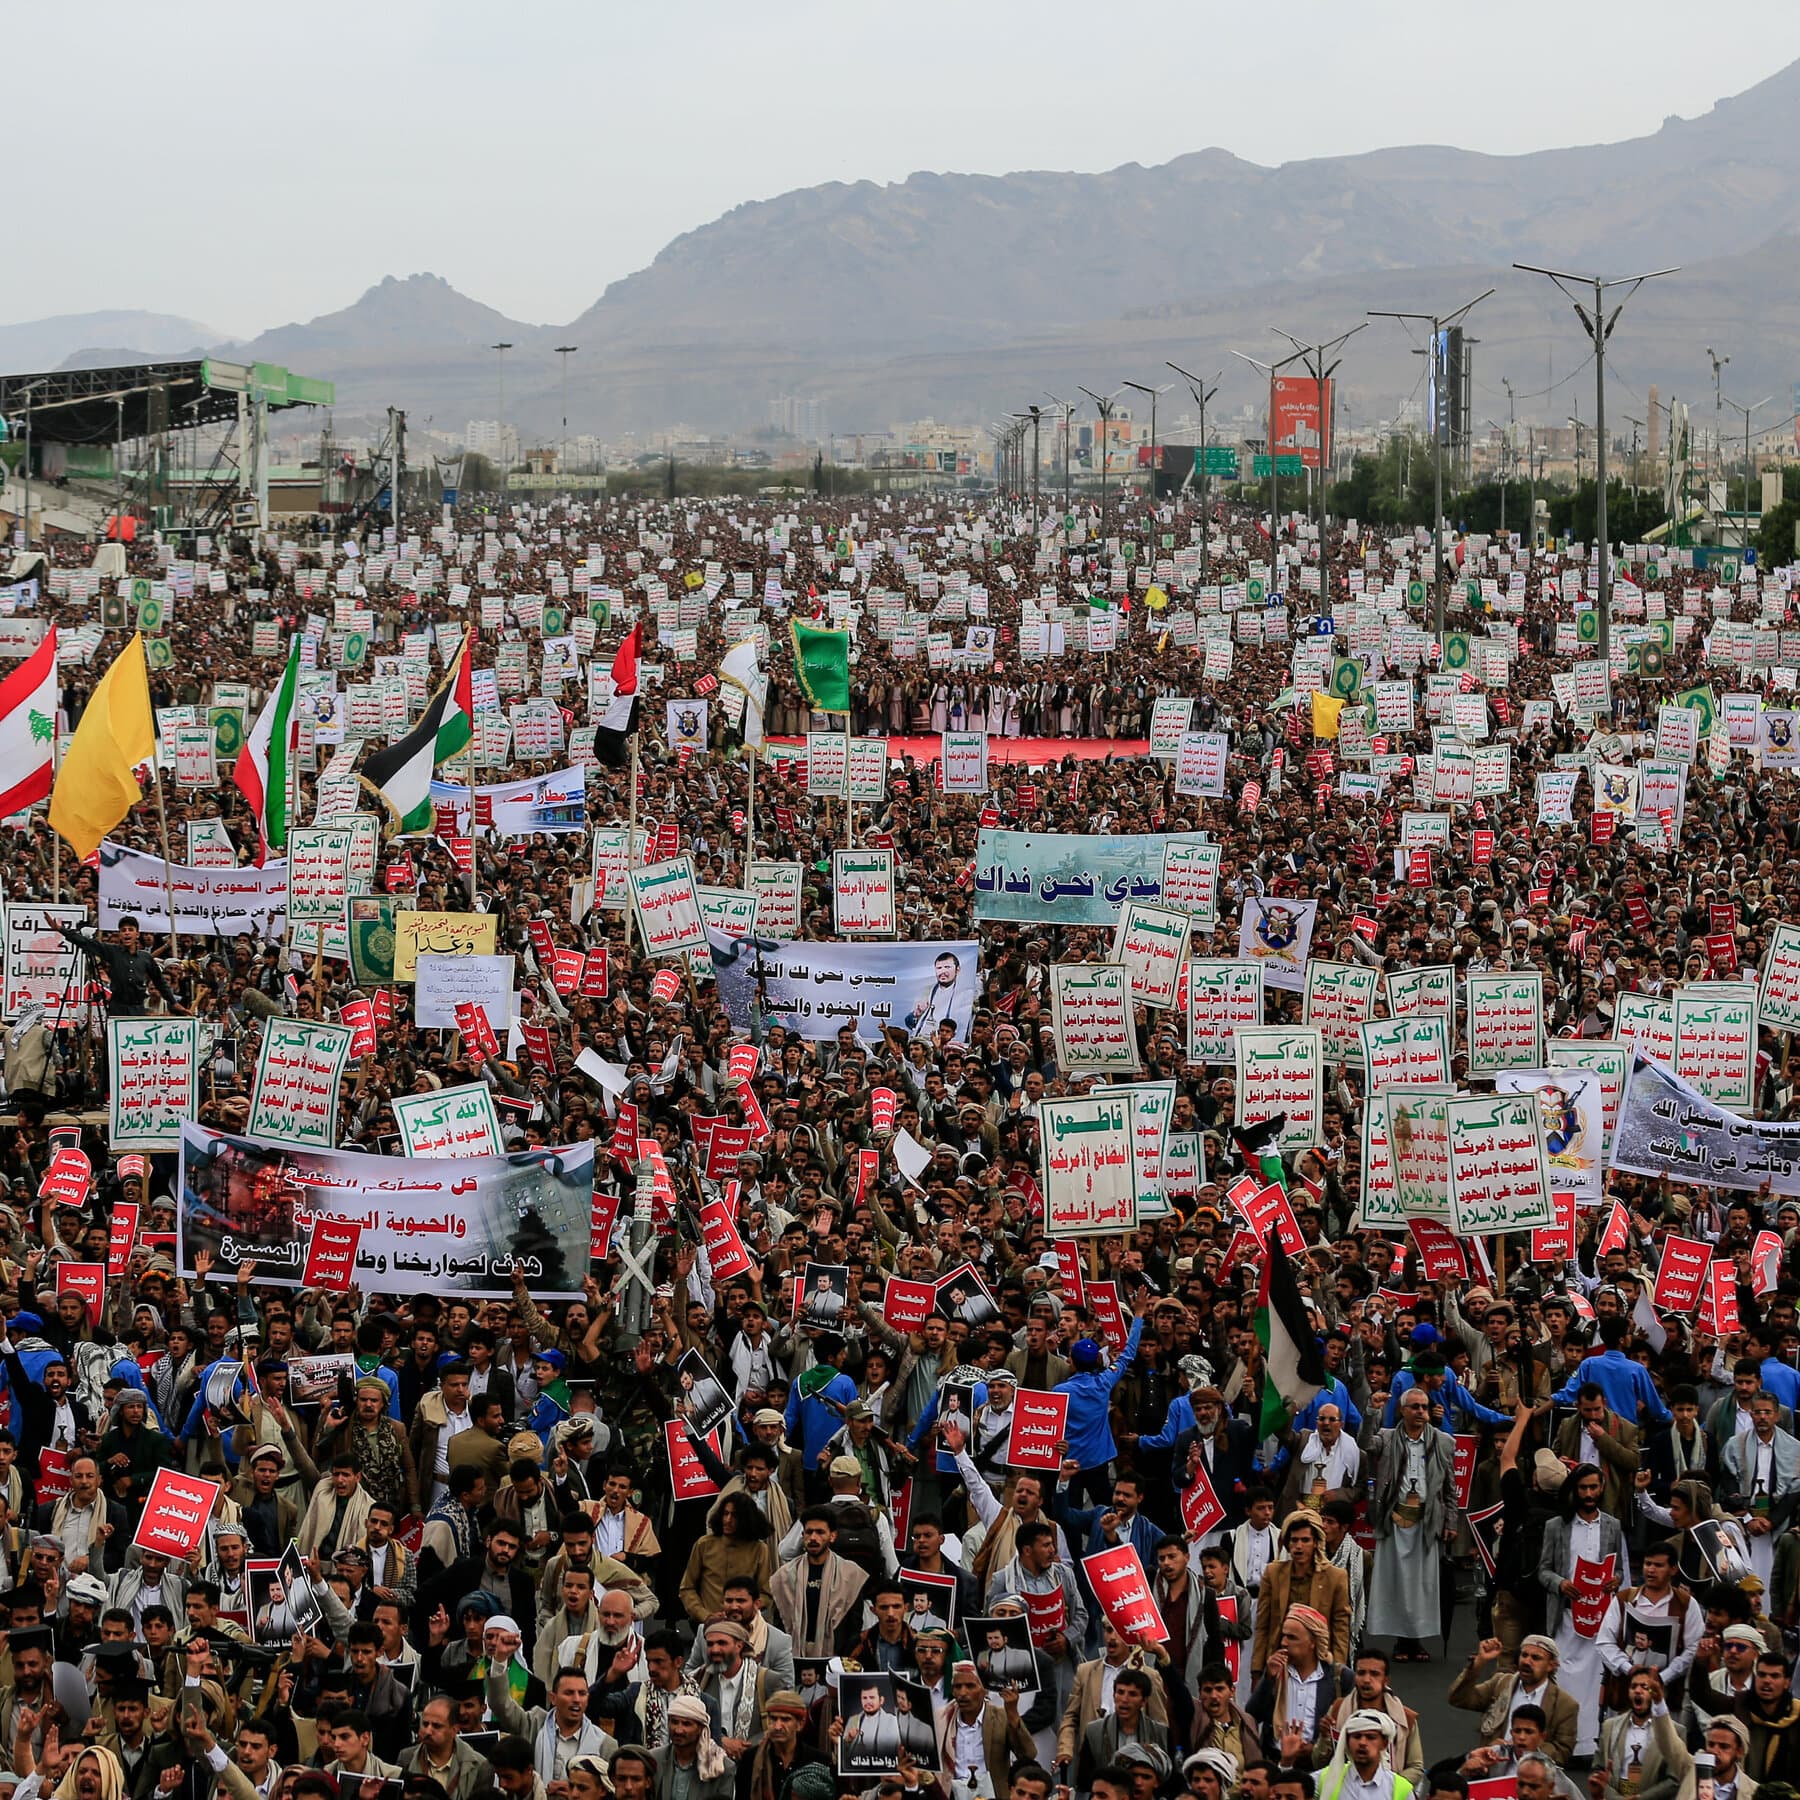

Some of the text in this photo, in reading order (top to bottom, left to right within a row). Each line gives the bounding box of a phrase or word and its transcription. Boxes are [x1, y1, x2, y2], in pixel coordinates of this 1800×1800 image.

[538, 789, 567, 804] مطار
[329, 835, 348, 848] الله
[841, 856, 886, 876] قاطعوا
[634, 864, 688, 892] قاطعوا
[213, 881, 261, 897] السعودي
[266, 881, 287, 894] على
[976, 865, 1161, 910] يدي نحن فداك
[107, 898, 142, 912] شؤوننا
[146, 902, 161, 917] في
[251, 908, 265, 917] عن
[467, 922, 487, 936] اليوم
[1130, 913, 1184, 938] قاطعوا
[12, 961, 55, 979] جبريل
[743, 959, 896, 990] سيدي نحن لك الفاء
[1235, 969, 1256, 985] الله
[1062, 969, 1121, 991] الله أكبر
[817, 1000, 865, 1018] الجنود
[871, 1002, 892, 1018] لك
[1096, 996, 1121, 1007] الموت
[1097, 1015, 1123, 1027] الموت
[1681, 1004, 1748, 1027] الله أكبر
[120, 1024, 191, 1049] الله أكبر
[272, 1028, 344, 1054] الله أكبر
[1065, 1032, 1088, 1045] اليهود
[1105, 1033, 1126, 1043] اللعنة
[1413, 1022, 1440, 1042] الله
[1718, 1032, 1747, 1044] الموت
[160, 1052, 190, 1067] الموت
[1067, 1047, 1101, 1063] للإسلام
[1410, 1049, 1441, 1063] الموت
[1718, 1049, 1747, 1062] الموت
[307, 1059, 335, 1075] الموت
[1678, 1066, 1703, 1079] اليهود
[160, 1072, 190, 1087] الموت
[303, 1081, 331, 1096] الموت
[165, 1093, 190, 1106] اللعنة
[1282, 1089, 1313, 1102] الموت
[1714, 1081, 1745, 1100] النصر
[121, 1092, 145, 1110] اليهود
[260, 1093, 328, 1116] اللعنة على اليهود
[1140, 1093, 1166, 1114] الله
[1651, 1098, 1677, 1120] الله
[256, 1110, 327, 1137] النصر للإسلام
[411, 1097, 485, 1134] الله أكبر
[1050, 1104, 1123, 1142] قاطعوا
[1452, 1100, 1533, 1137] الله أكبر
[1680, 1105, 1724, 1132] سبيل
[455, 1126, 489, 1144] الموت
[1453, 1134, 1536, 1155] الموت لأمريكا
[59, 1155, 88, 1170] جمعة
[1049, 1136, 1129, 1174] البضائع الأمريكية
[1649, 1136, 1792, 1176] وتأثير في الموقف
[1456, 1160, 1499, 1181] لإسرائيل
[1501, 1158, 1538, 1176] الموت
[53, 1171, 85, 1183] التحذير
[450, 1175, 478, 1195] كل
[1086, 1173, 1092, 1193] و
[1459, 1182, 1541, 1205] اللعنة على اليهود
[1052, 1198, 1132, 1225] الإسرائيلية
[1253, 1199, 1279, 1218] جمعة
[1461, 1201, 1545, 1228] النصر للإسلام
[385, 1209, 467, 1238] والحيوية
[1419, 1226, 1447, 1234] جمعة
[321, 1229, 351, 1245] جمعة
[220, 1236, 300, 1267] المسيرة
[315, 1249, 349, 1264] التحذير
[1671, 1247, 1702, 1265] جمعة
[392, 1249, 486, 1277] لصواريخنا
[492, 1254, 542, 1277] هدف
[66, 1271, 97, 1285] جمعة
[311, 1267, 345, 1283] والنفير
[1665, 1268, 1699, 1282] التحذير
[894, 1290, 927, 1305] جمعة
[1662, 1287, 1693, 1301] والنفير
[1023, 1400, 1058, 1417] جمعة
[1019, 1423, 1057, 1436] التحذير
[1017, 1443, 1053, 1458] والنفير
[164, 1481, 204, 1504] جمعة
[155, 1504, 200, 1524] التحذير
[149, 1524, 191, 1547] والنفير
[1101, 1561, 1137, 1583] جمعة
[1111, 1586, 1147, 1612] التحذير
[1123, 1613, 1156, 1635] والنفير
